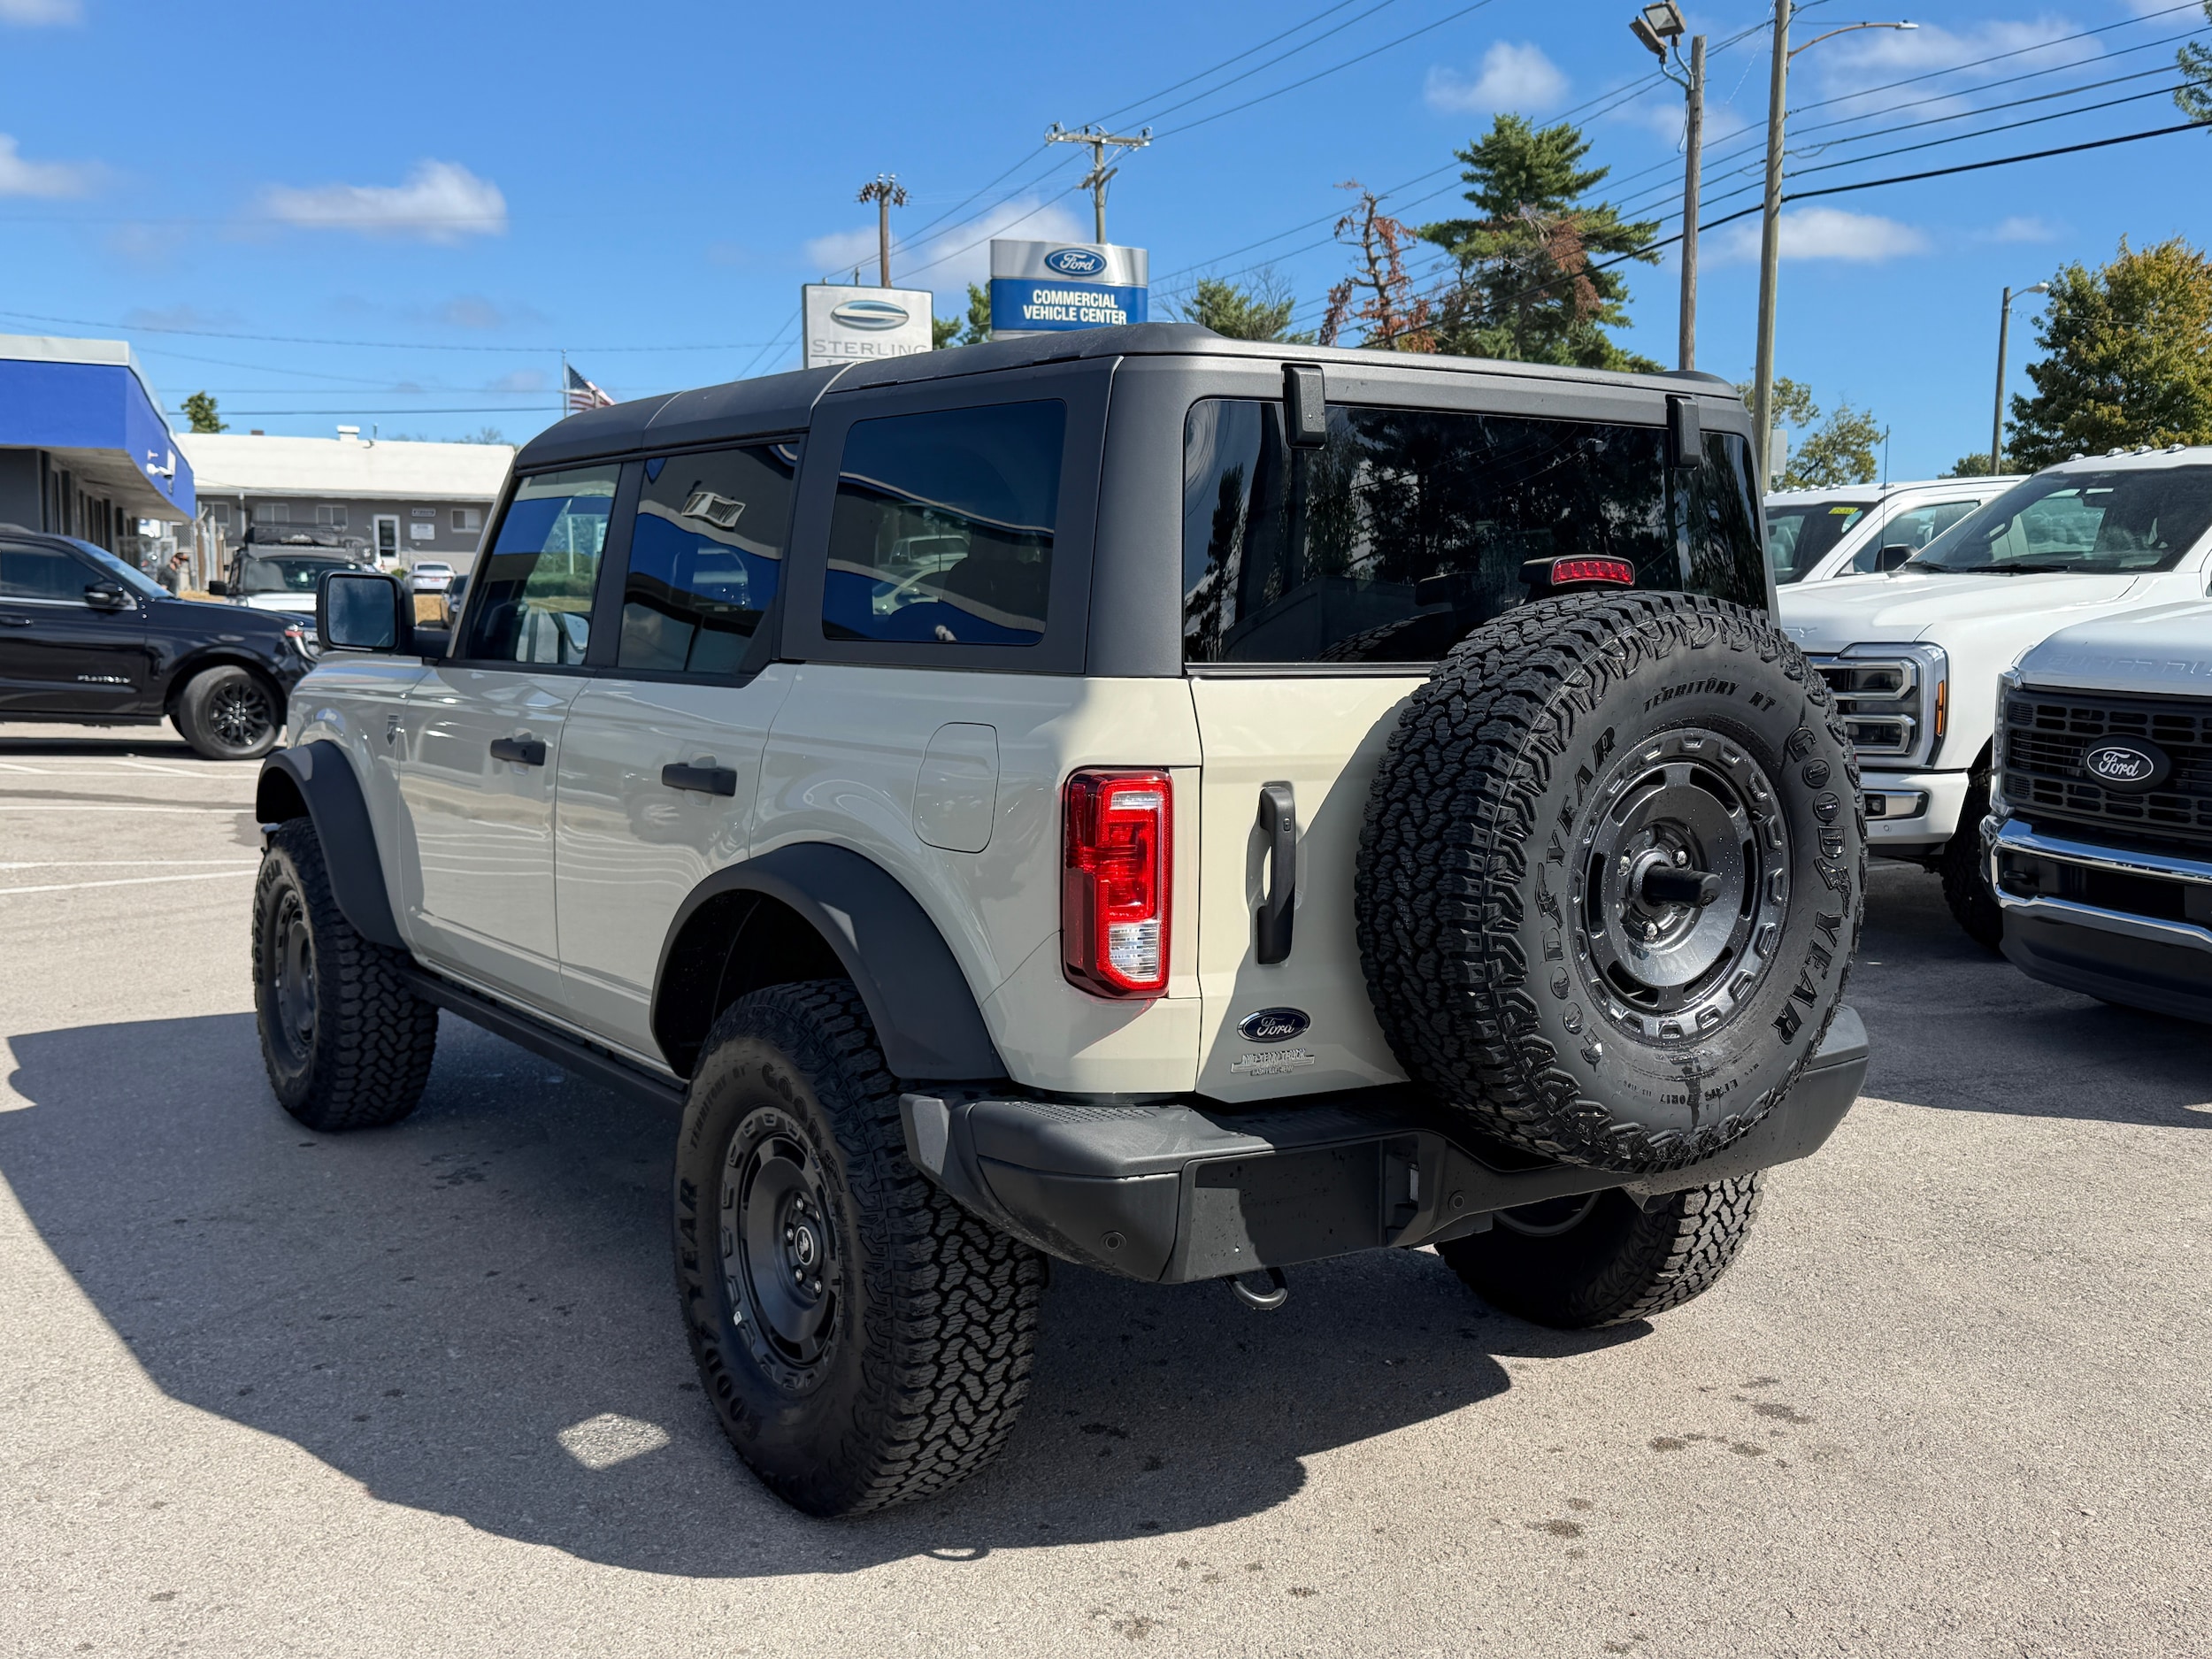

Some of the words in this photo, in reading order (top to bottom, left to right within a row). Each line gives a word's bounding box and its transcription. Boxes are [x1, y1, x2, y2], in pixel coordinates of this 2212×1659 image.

[1059, 252, 1095, 271] Ford
[1033, 289, 1118, 309] COMMERCIAL
[1023, 304, 1078, 321] VEHICLE
[1079, 307, 1127, 325] CENTER
[1643, 677, 1740, 713] TERRITORY
[1748, 691, 1777, 712] RT
[2099, 750, 2140, 777] Ford
[1256, 1016, 1296, 1036] Ford
